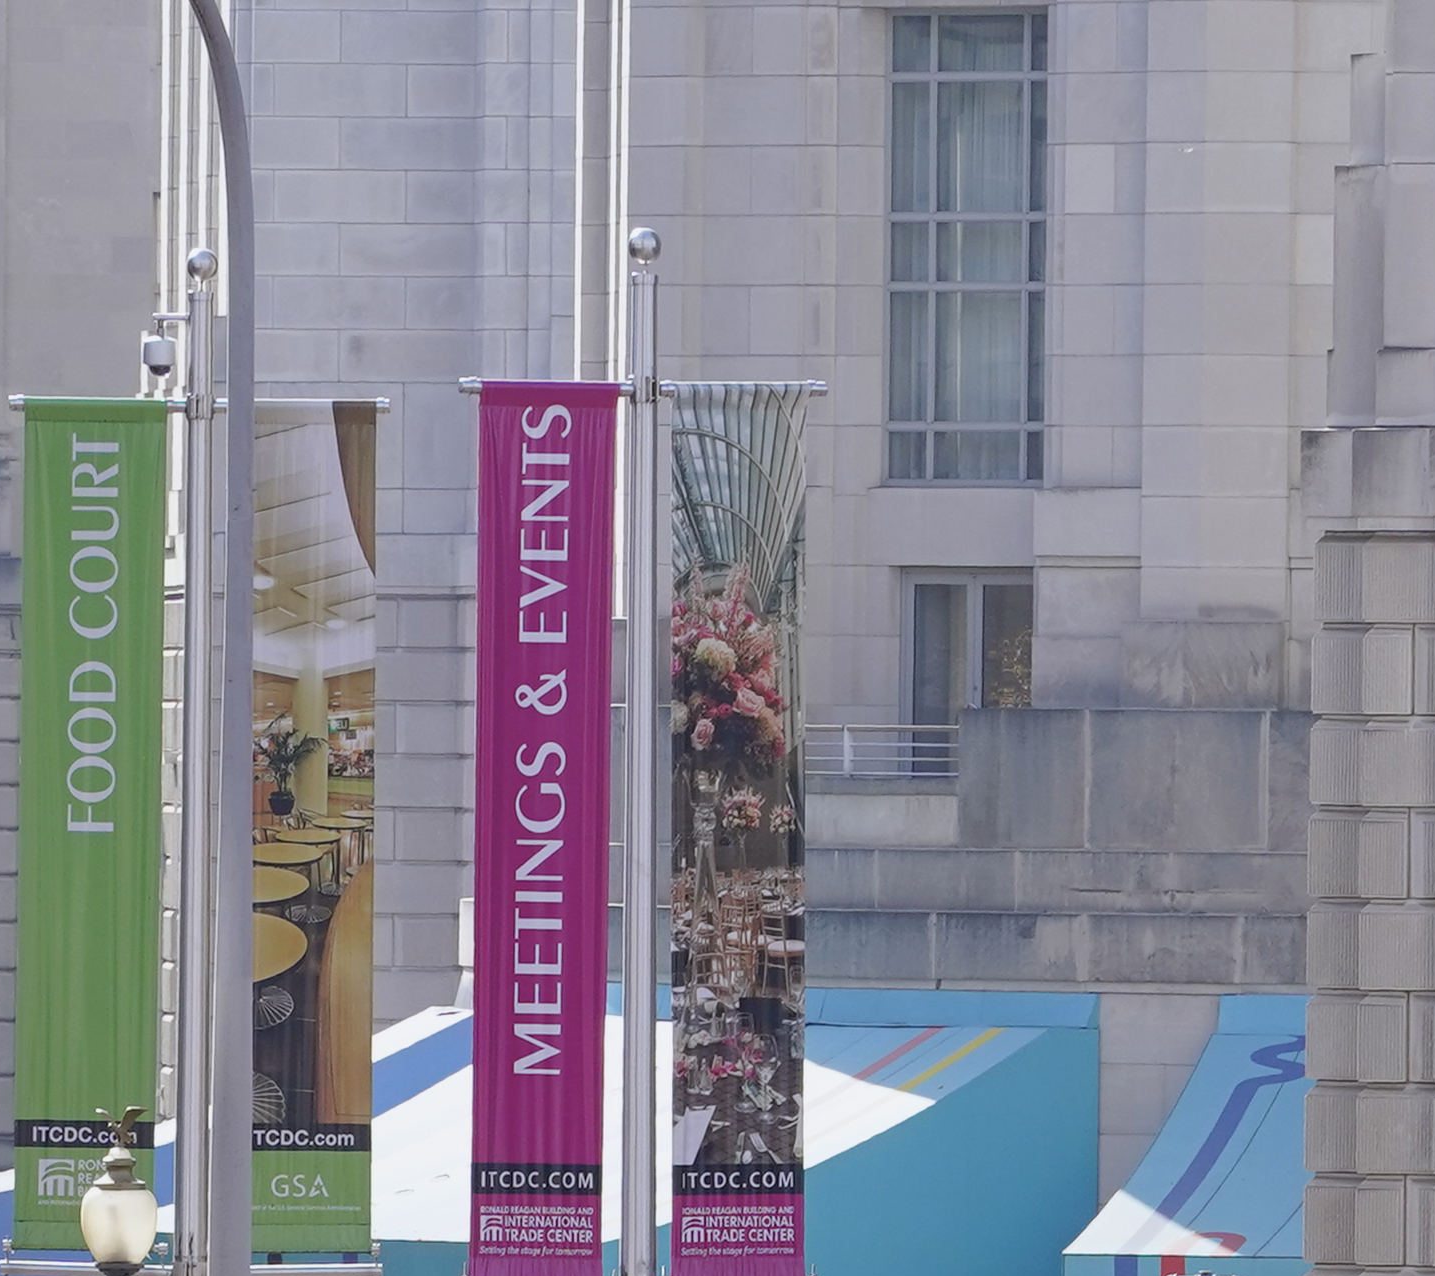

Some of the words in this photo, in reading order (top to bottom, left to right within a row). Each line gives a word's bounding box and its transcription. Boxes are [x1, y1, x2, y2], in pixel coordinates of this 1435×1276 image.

[518, 404, 572, 644] EVENTS
[68, 433, 120, 640] COURT
[515, 668, 569, 716] &
[66, 660, 117, 833] FOOD
[513, 741, 567, 1076] MEETINGS
[270, 1174, 330, 1199] GSA
[480, 1170, 595, 1190] ITCDC.COM
[681, 1170, 795, 1189] ITCDC.COM
[504, 1215, 594, 1228] INTERNATIONAL
[705, 1215, 795, 1228] INTERNATIONAL
[504, 1229, 546, 1243] TRADE
[547, 1229, 594, 1244] CENTER
[705, 1229, 747, 1243] TRADE
[748, 1229, 795, 1243] CENTER
